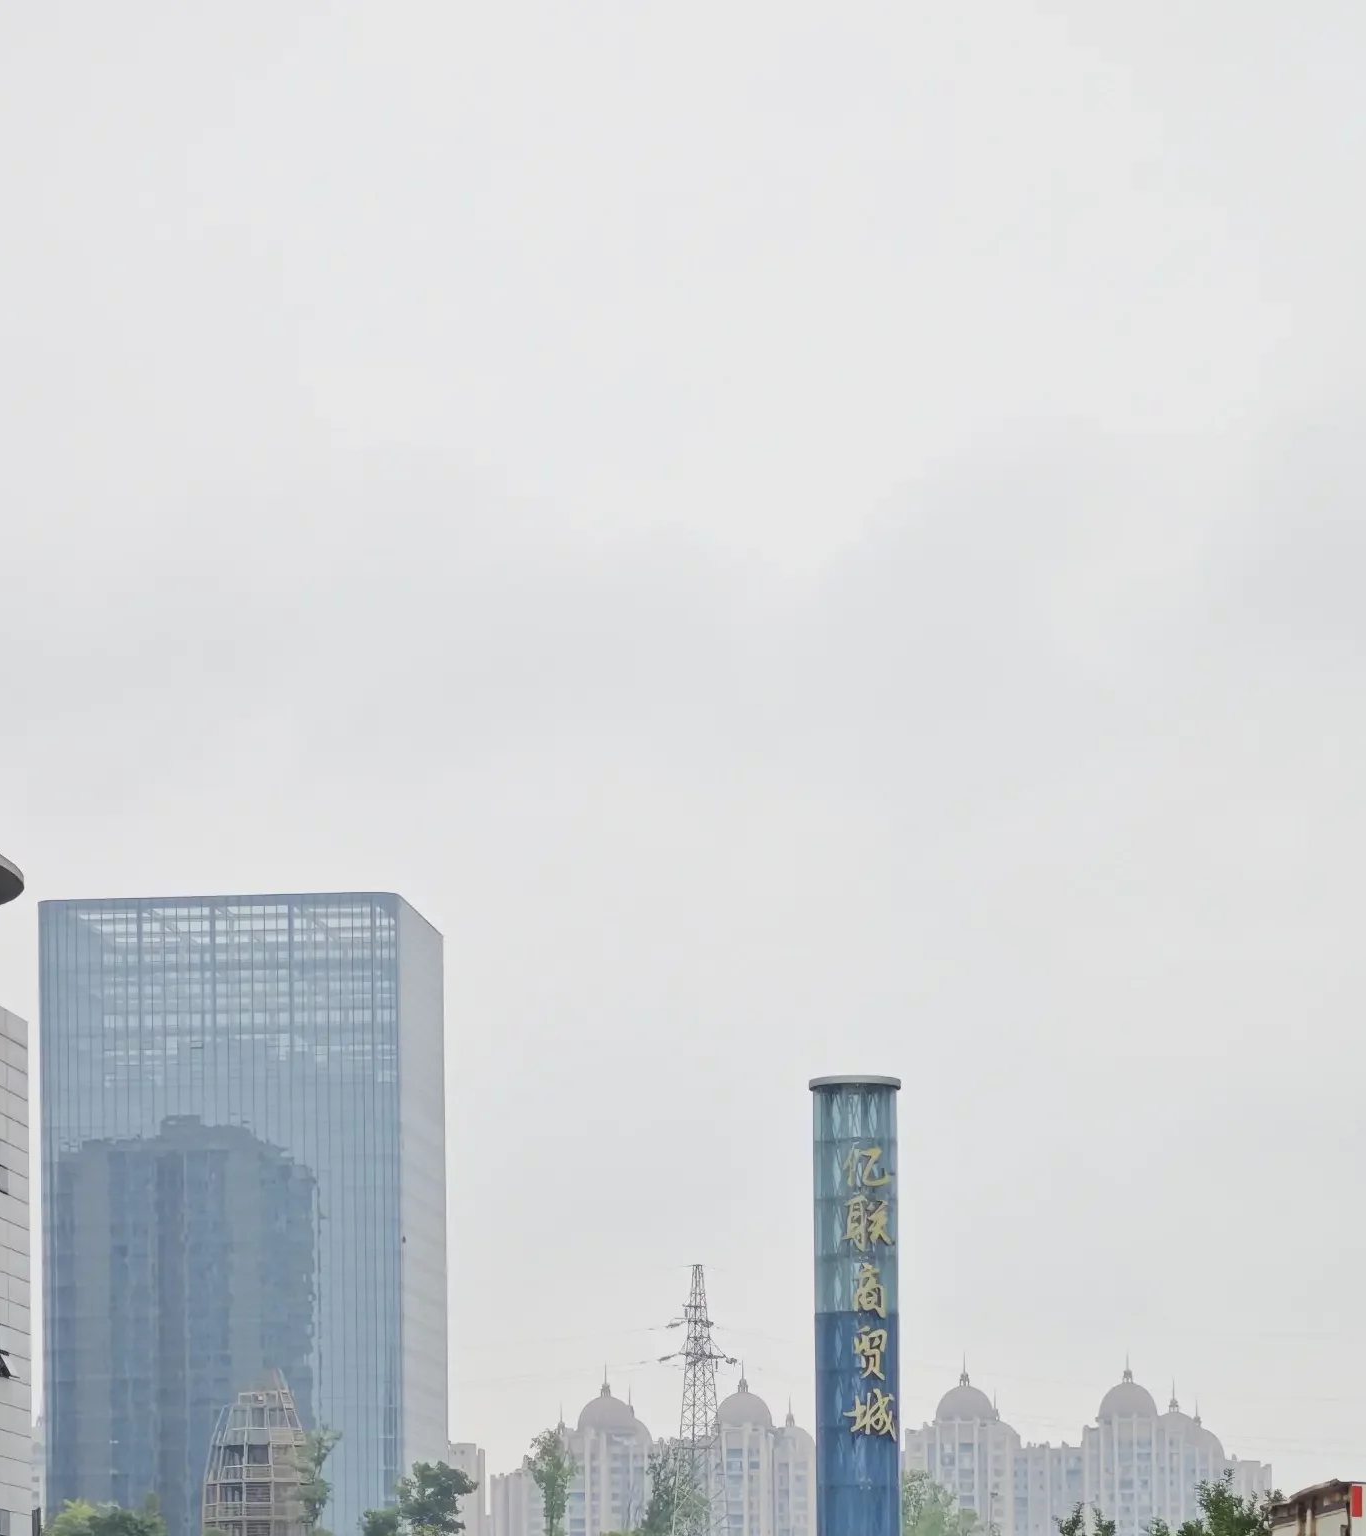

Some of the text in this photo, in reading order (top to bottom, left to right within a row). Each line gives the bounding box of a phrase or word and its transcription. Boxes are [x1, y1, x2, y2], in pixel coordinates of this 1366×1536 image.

[841, 1144, 897, 1443] 亿联商贸城
